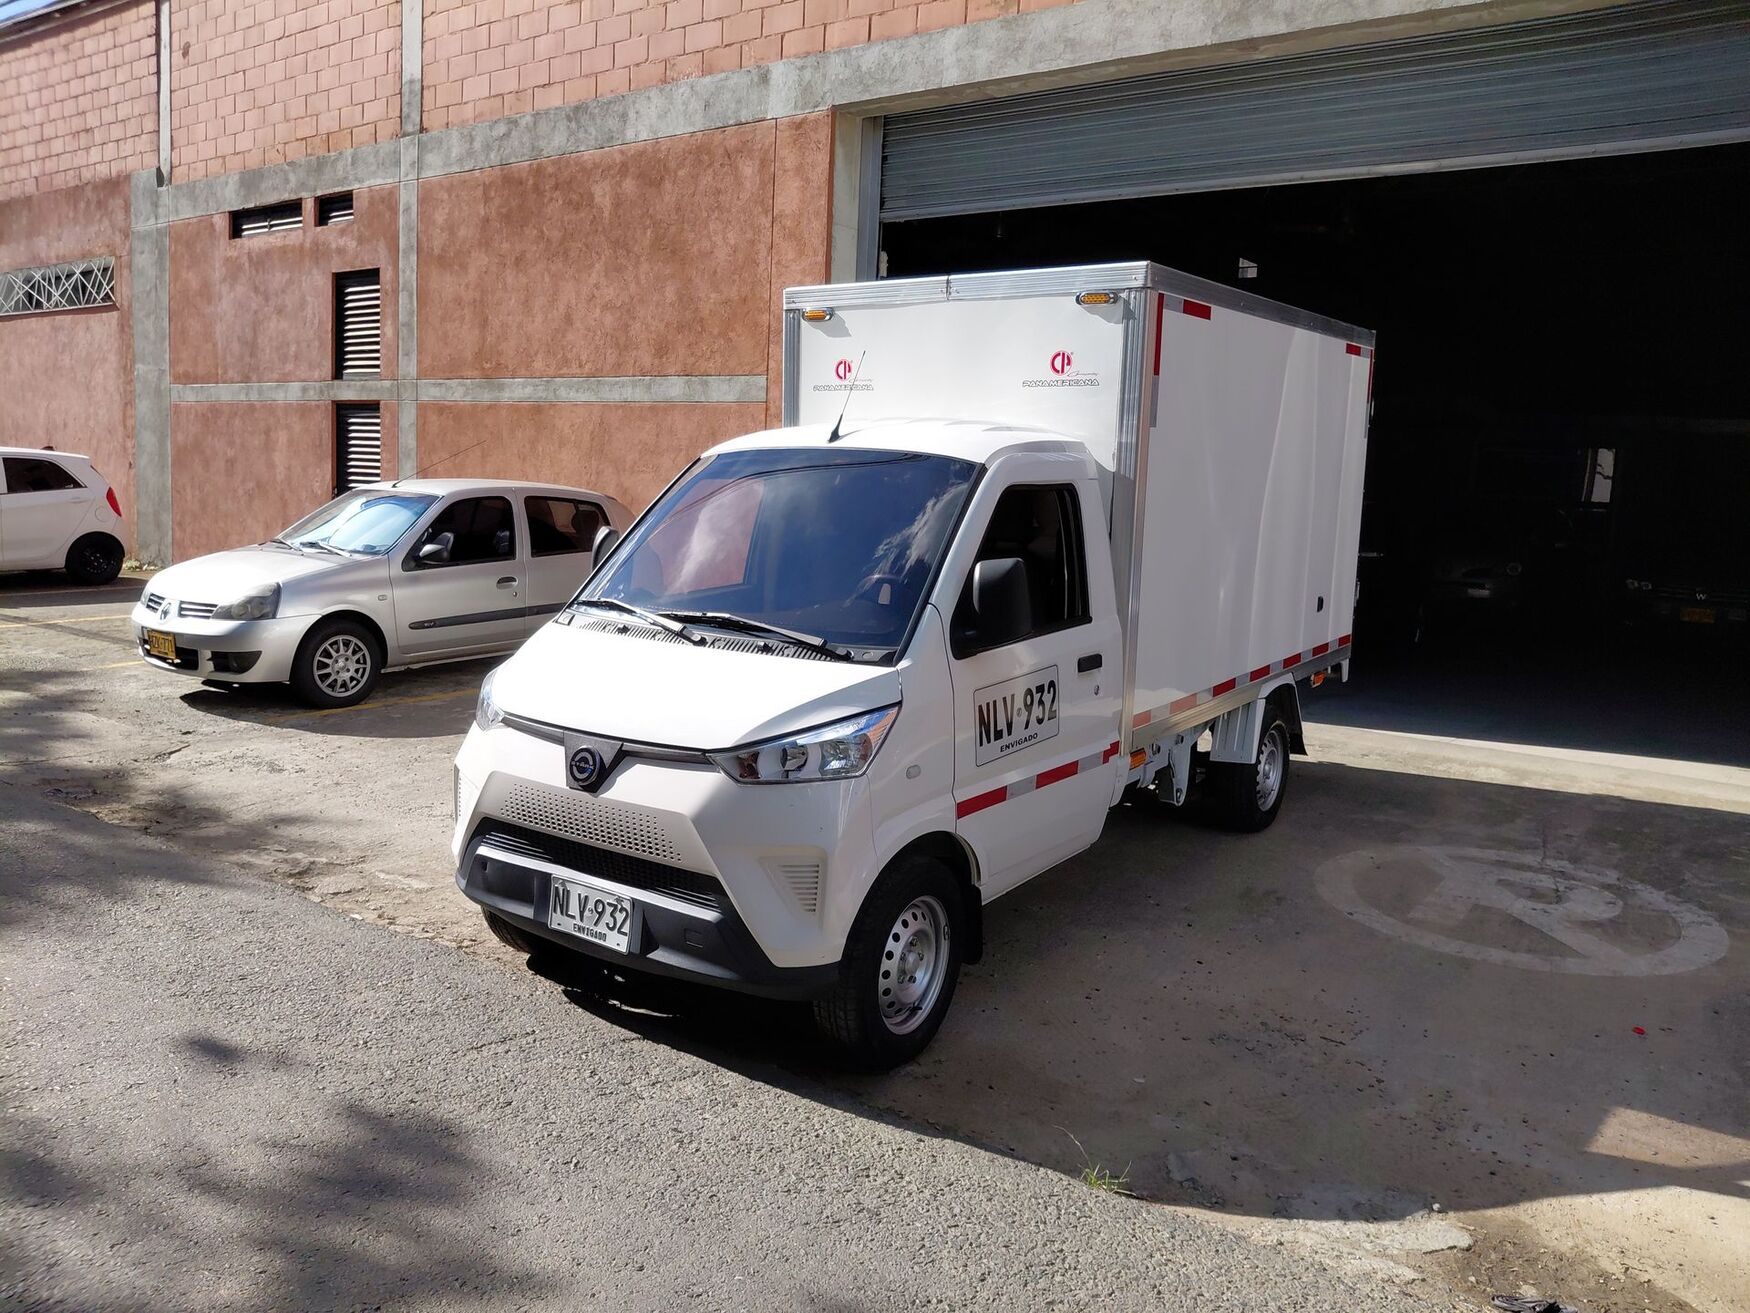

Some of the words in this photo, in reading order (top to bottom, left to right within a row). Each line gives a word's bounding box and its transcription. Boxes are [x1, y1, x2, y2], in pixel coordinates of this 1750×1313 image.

[1022, 378, 1100, 388] PANAMERICANA
[1000, 732, 1039, 753] ENVIGADO
[572, 923, 607, 942] ENVIGADO
